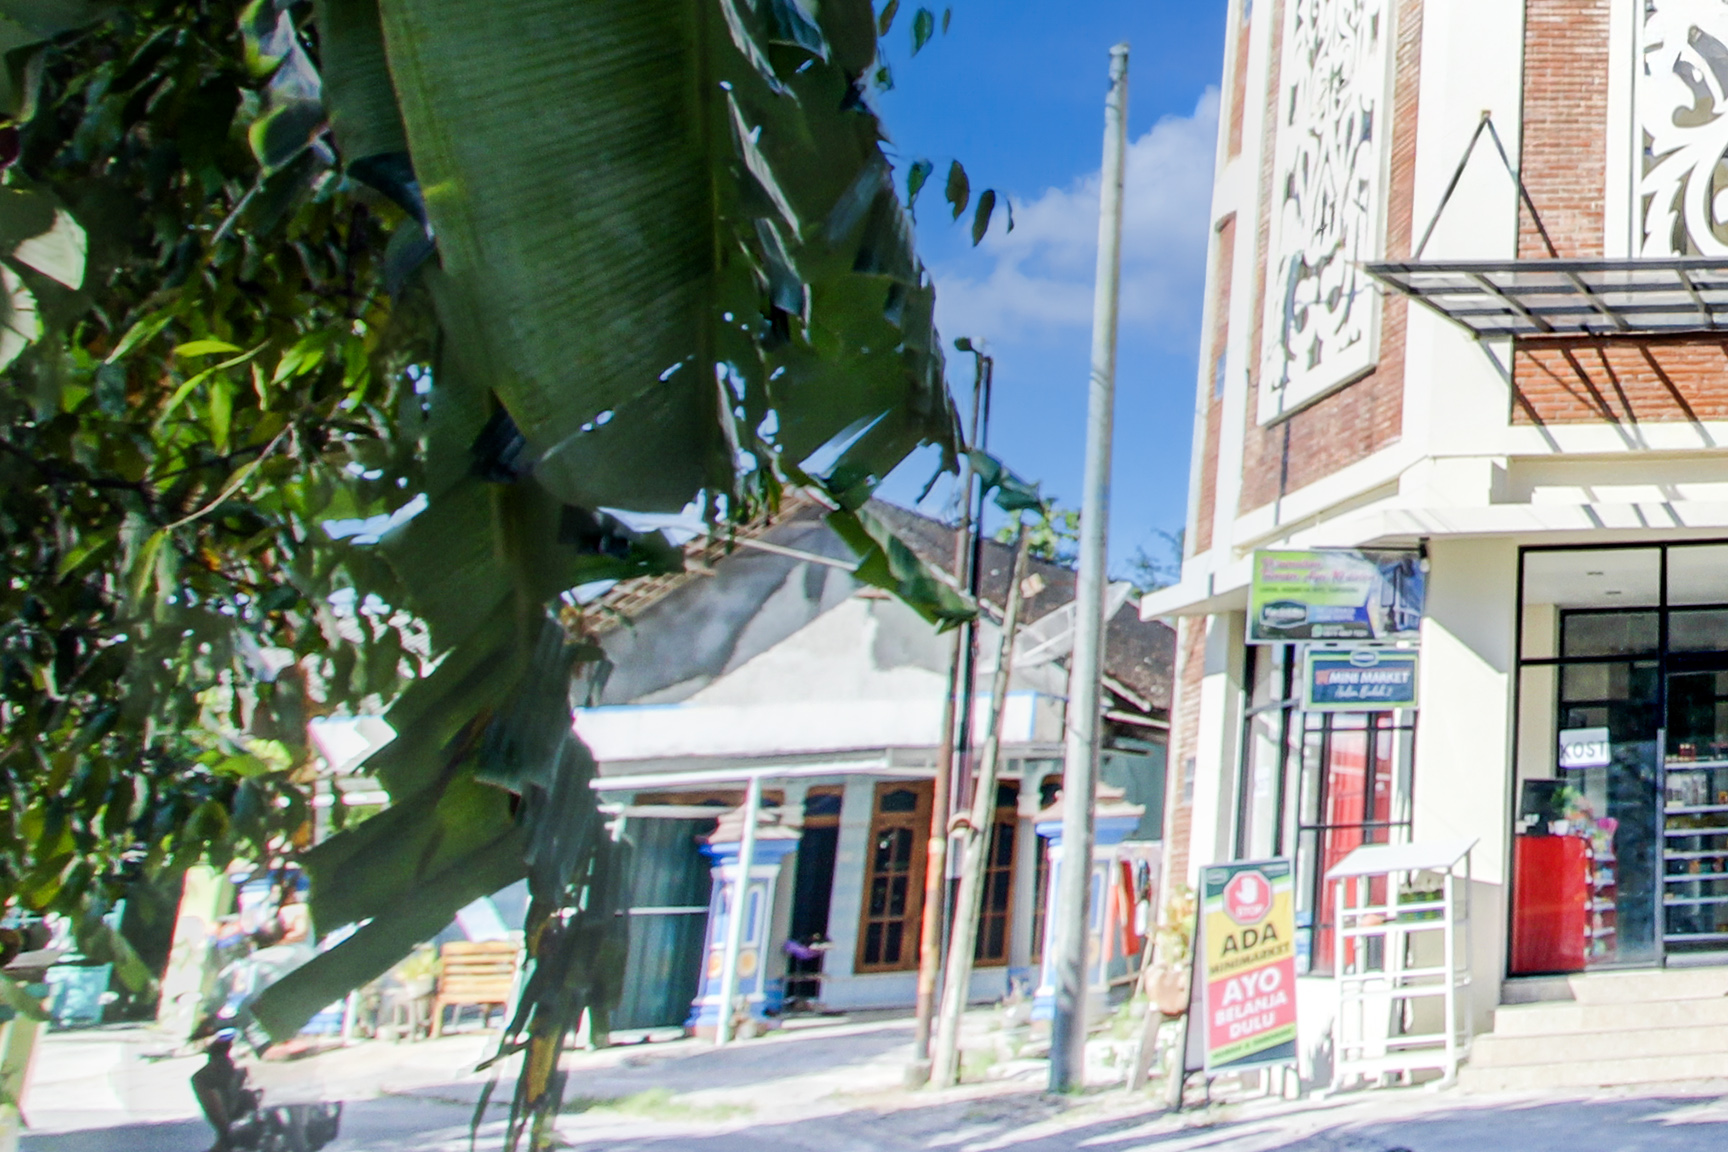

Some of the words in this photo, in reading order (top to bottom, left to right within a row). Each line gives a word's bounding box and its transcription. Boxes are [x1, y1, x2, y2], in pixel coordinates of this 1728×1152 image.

[1328, 670, 1359, 684] MINI
[1360, 670, 1411, 684] MARKET
[1560, 741, 1606, 759] KOST
[1221, 921, 1279, 957] ADA
[1221, 966, 1282, 1007] AYO
[1214, 989, 1288, 1027] BELANJA
[1229, 1010, 1276, 1040] DULU
